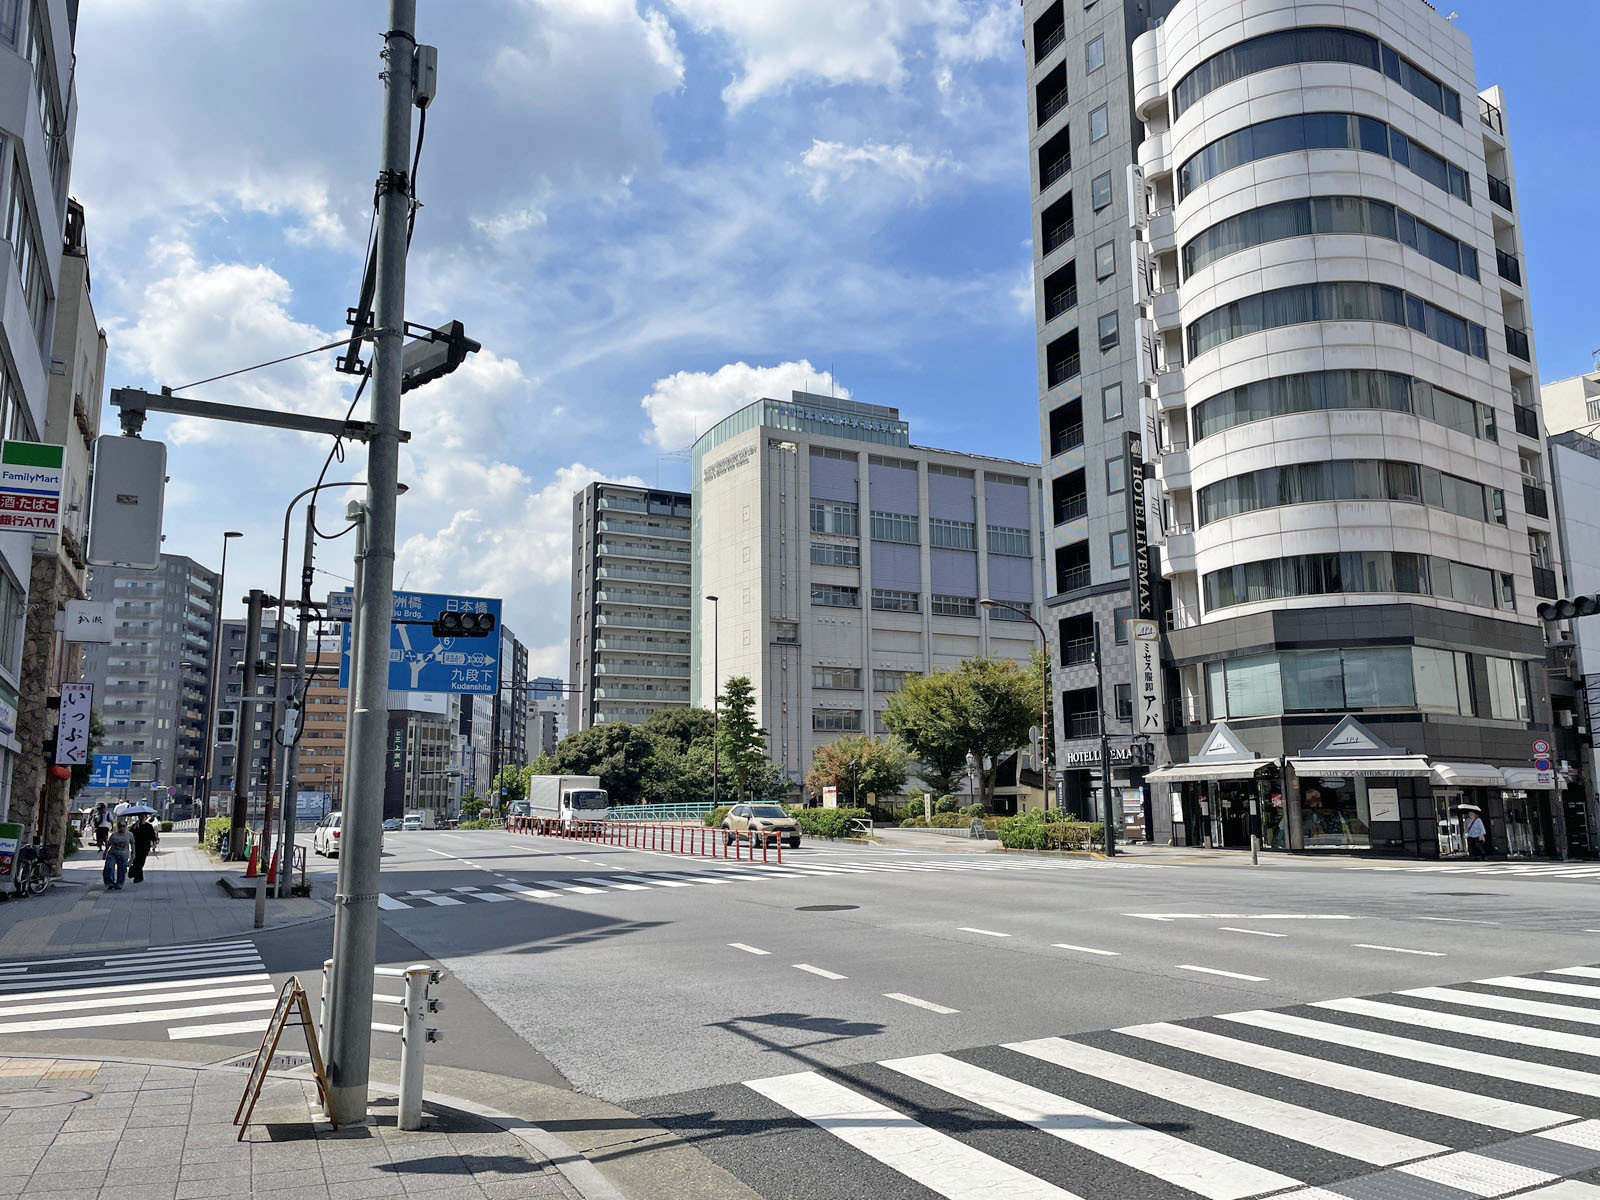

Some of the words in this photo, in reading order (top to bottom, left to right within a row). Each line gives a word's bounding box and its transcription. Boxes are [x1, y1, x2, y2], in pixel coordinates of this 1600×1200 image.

[2, 471, 59, 484] FamilyMart
[1132, 466, 1146, 525] HOTEL
[0, 515, 56, 529] 銀行ATM
[333, 596, 352, 606] 浅草
[393, 595, 423, 609] 洲橋
[446, 599, 488, 613] 日本橋
[472, 656, 484, 664] 302
[451, 668, 493, 682] 九段下
[451, 682, 491, 691] Kudanshita
[65, 692, 86, 762] いっぷく
[1536, 743, 1546, 751] 30
[1067, 750, 1094, 763] HOTEL
